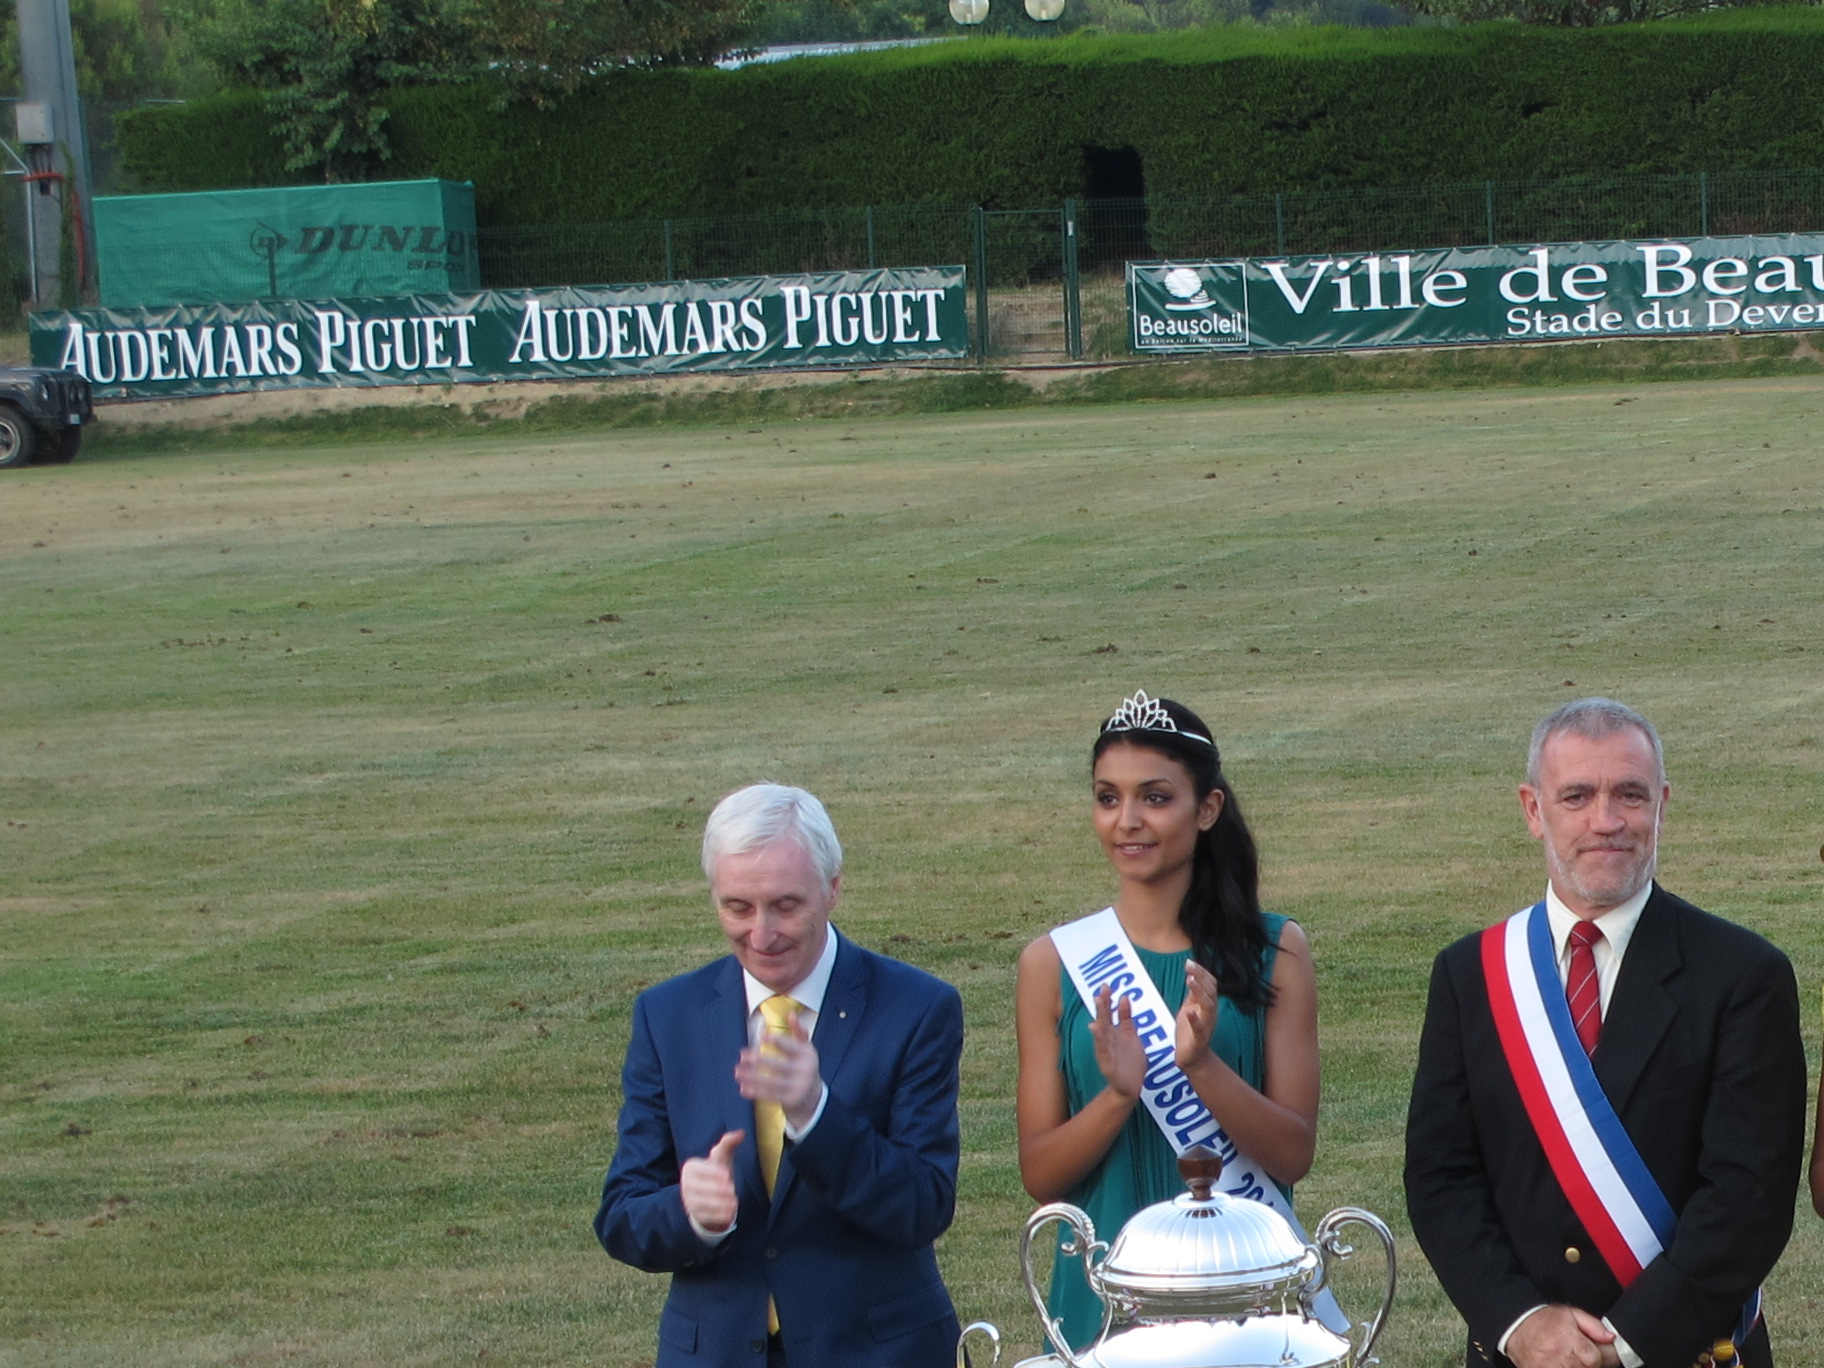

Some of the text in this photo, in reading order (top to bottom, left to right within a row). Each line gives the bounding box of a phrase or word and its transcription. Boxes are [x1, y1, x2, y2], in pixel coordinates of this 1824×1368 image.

[1260, 254, 1468, 315] Ville
[1499, 248, 1609, 304] de
[60, 310, 476, 384] AUDEMARS PIGUET
[508, 285, 946, 364] AUDEMARS PIGUET
[1140, 311, 1242, 337] Beausoleil
[1506, 303, 1623, 336] Stade
[1636, 301, 1692, 330] du
